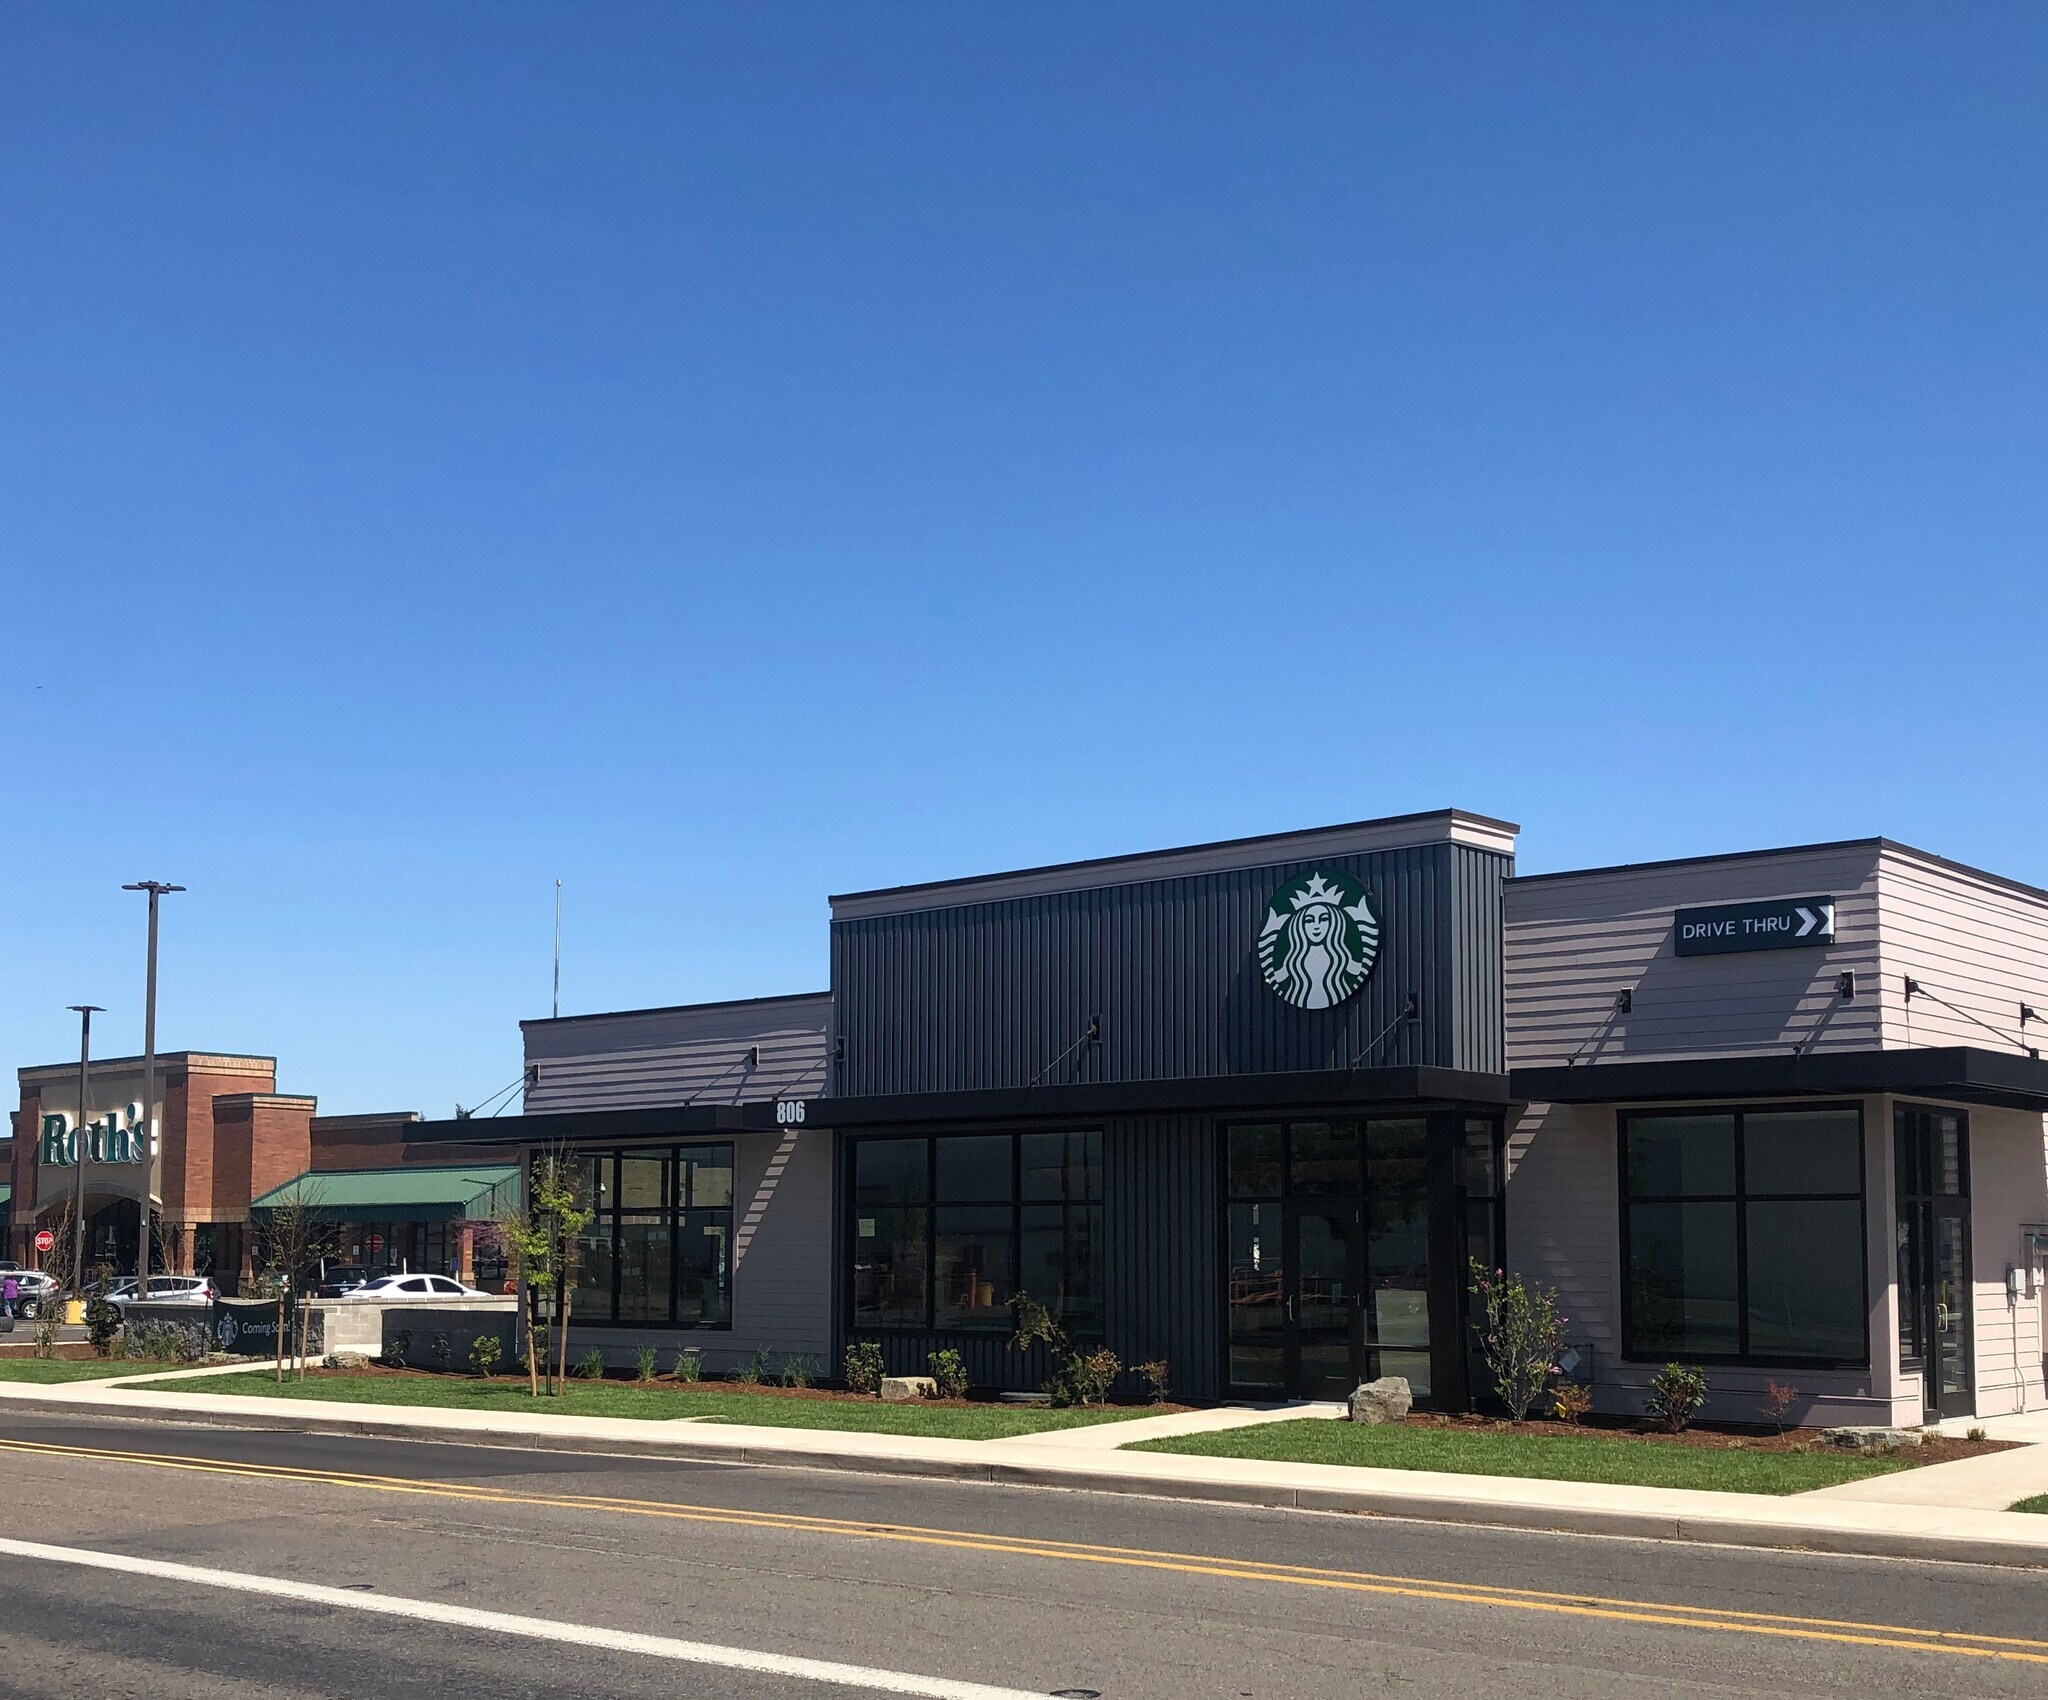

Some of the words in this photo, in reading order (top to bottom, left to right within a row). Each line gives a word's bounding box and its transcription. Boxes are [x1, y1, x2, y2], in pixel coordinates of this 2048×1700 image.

[1683, 921, 1736, 939] DRIVE
[1742, 916, 1791, 934] THRU
[777, 1101, 805, 1124] 806
[242, 1322, 271, 1336] Coming
[271, 1320, 291, 1333] Son!
